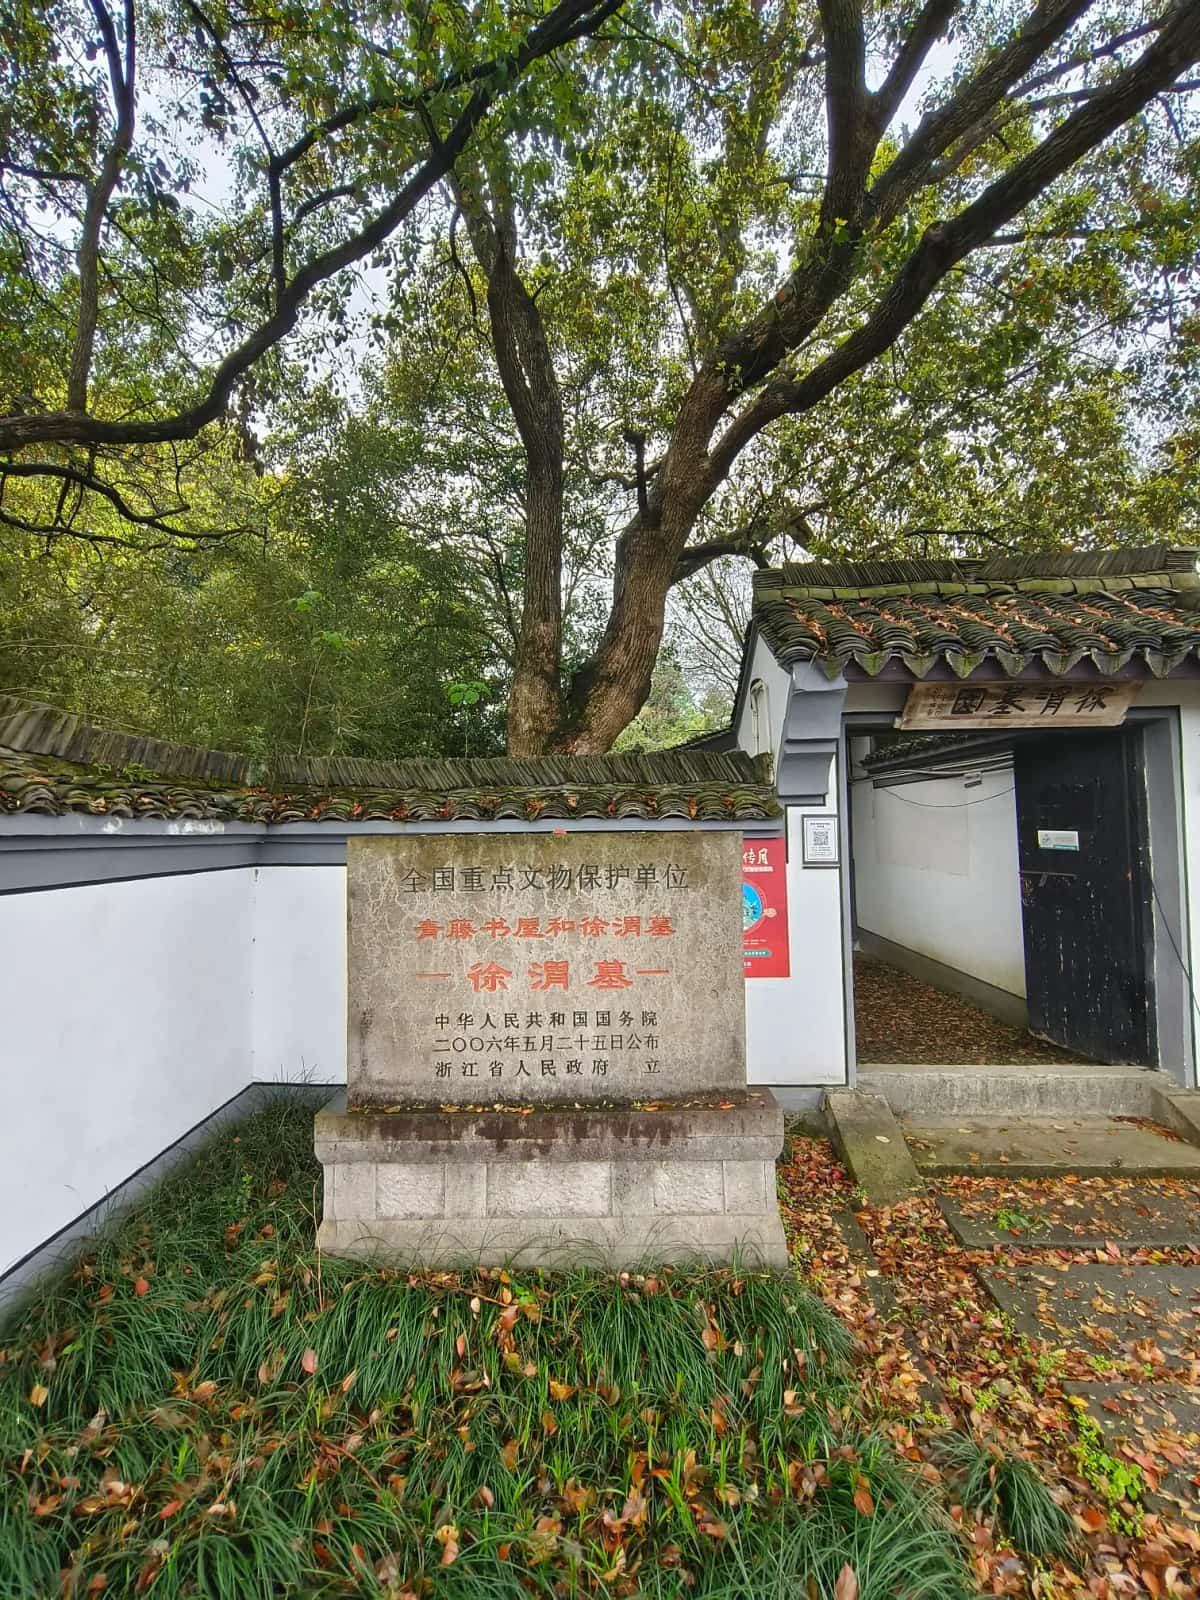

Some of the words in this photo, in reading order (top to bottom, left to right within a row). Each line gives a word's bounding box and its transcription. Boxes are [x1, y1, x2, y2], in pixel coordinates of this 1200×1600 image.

[401, 864, 689, 893] 全国重点文物保护单位
[415, 915, 676, 940] 青藤书屋和徐渭墓
[434, 1011, 658, 1030] 中华人民共和国国务院
